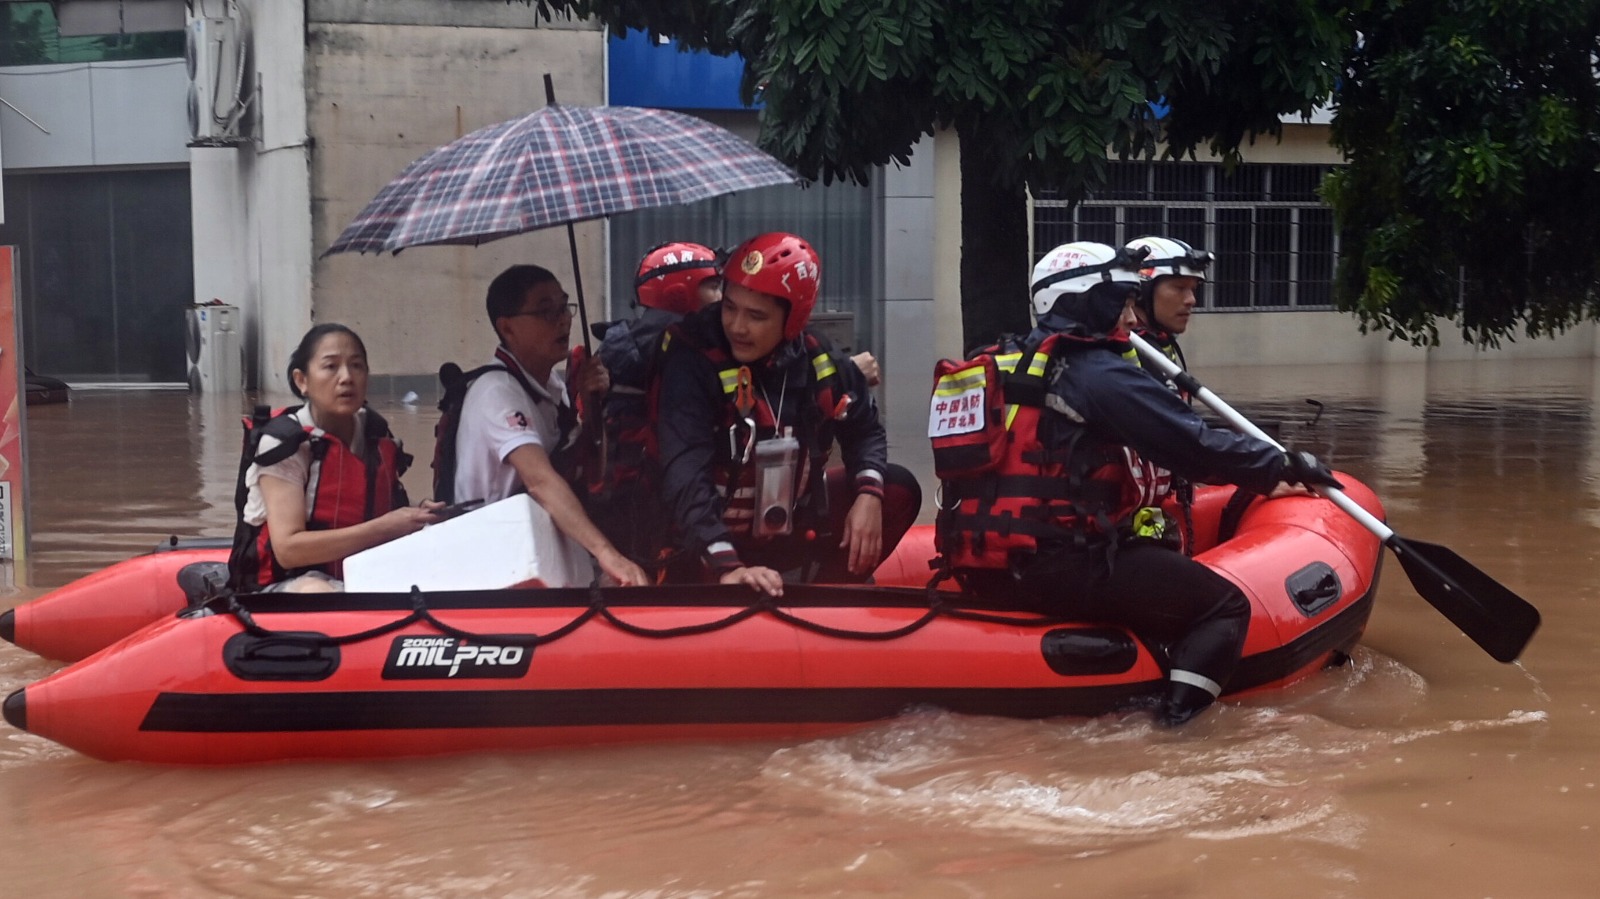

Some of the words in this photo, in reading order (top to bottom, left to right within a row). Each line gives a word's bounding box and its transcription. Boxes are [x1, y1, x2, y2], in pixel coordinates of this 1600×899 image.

[936, 393, 981, 416] 中国消防
[515, 411, 528, 427] 3
[937, 413, 976, 431] 广西北海
[402, 638, 455, 647] ZODIAC
[396, 646, 524, 677] MILPRO
